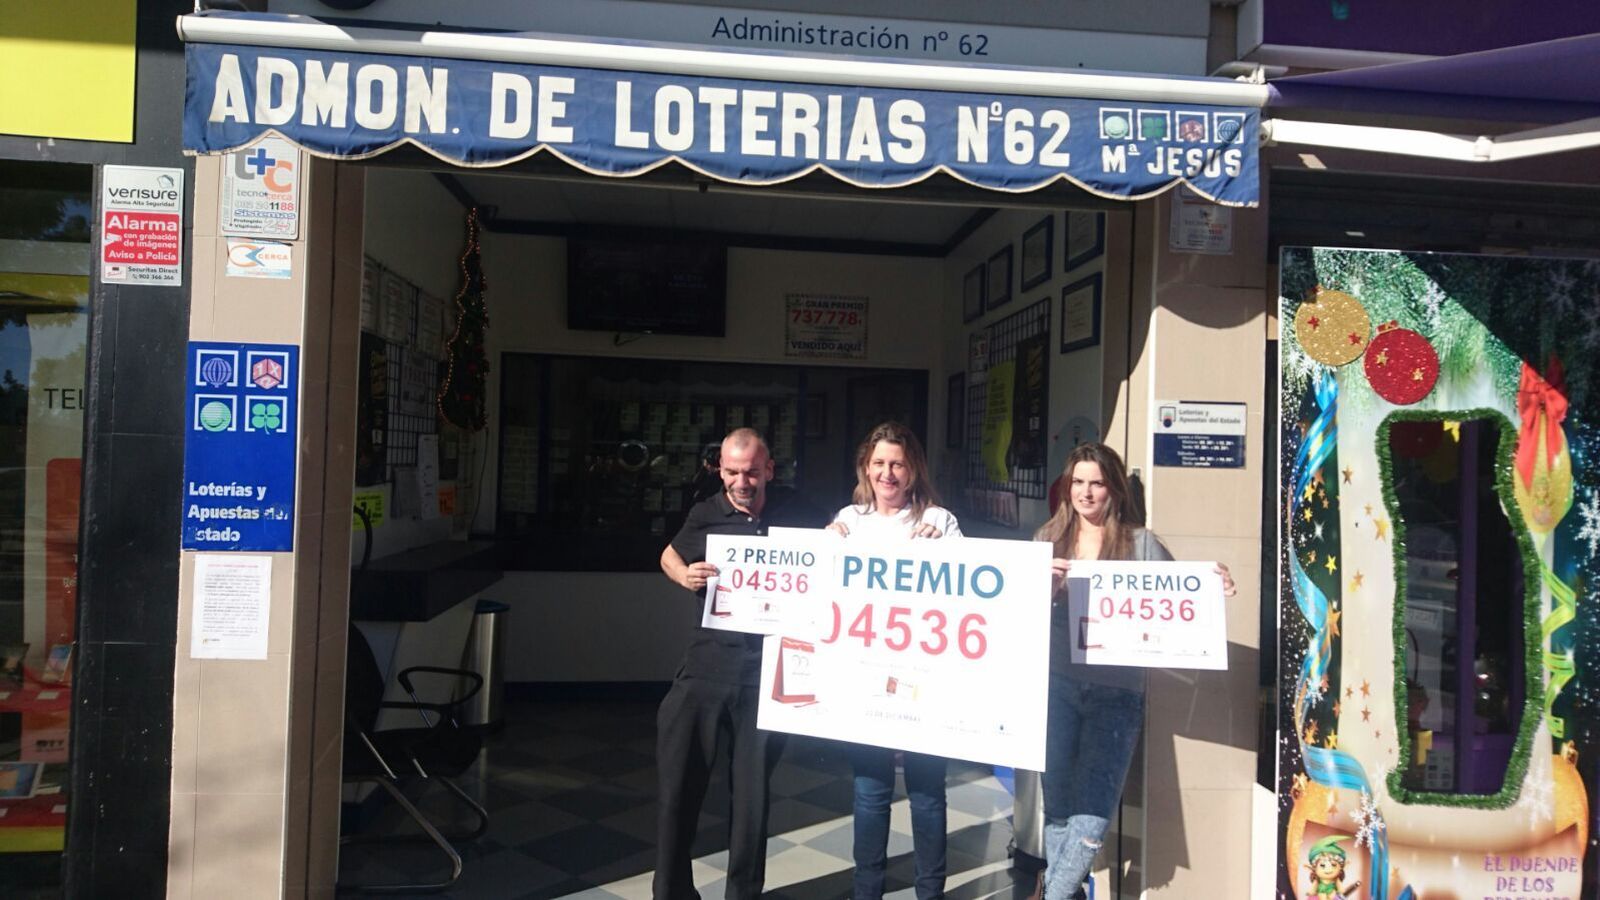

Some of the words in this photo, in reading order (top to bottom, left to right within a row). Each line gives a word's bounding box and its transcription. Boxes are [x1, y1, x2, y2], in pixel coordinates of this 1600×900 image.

[711, 17, 908, 50] Administración
[923, 31, 949, 52] nº
[958, 34, 989, 55] 62
[209, 54, 460, 134] ADMON.
[489, 71, 575, 143] DE
[614, 80, 926, 164] LOTERIAS
[1147, 146, 1242, 177] JESUS
[108, 187, 178, 200] verisure
[146, 200, 175, 208] Seguridad
[107, 215, 178, 231] Alarma
[123, 239, 135, 247] de
[136, 239, 177, 250] imágenes
[139, 232, 177, 242] grabación
[108, 250, 135, 259] Aviso
[145, 251, 177, 260] Policía
[189, 482, 253, 497] Loterías
[256, 486, 267, 500] y
[188, 504, 260, 522] Apuestas
[195, 527, 241, 542] stado
[727, 548, 737, 562] 2
[744, 548, 815, 567] PREMIO
[732, 569, 809, 594] 04536
[842, 555, 1005, 599] PREMIO
[1092, 574, 1103, 590] 2
[1112, 574, 1201, 592] PREMIO
[1100, 597, 1195, 622] 04536
[1484, 855, 1505, 872] EL
[1509, 855, 1578, 873] DUENDE
[1496, 877, 1518, 892] DE
[1522, 877, 1556, 893] LOS
